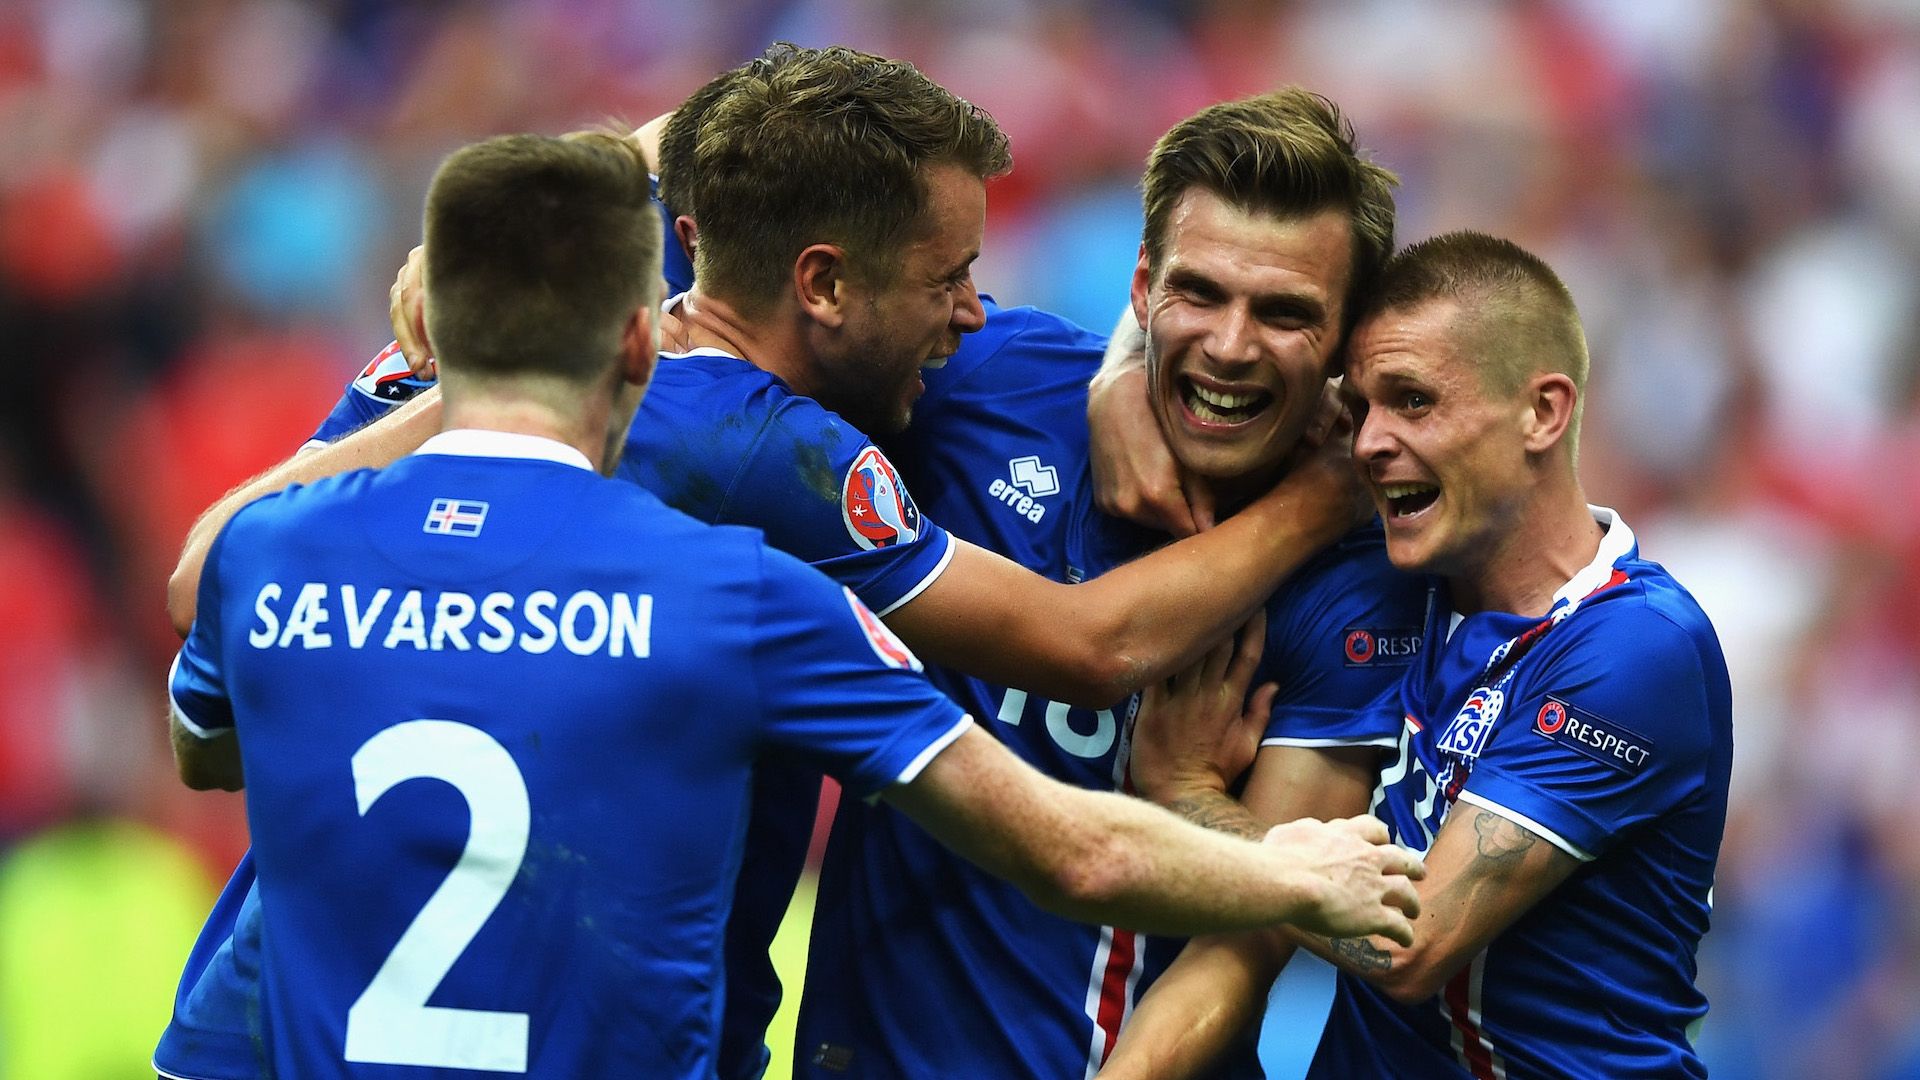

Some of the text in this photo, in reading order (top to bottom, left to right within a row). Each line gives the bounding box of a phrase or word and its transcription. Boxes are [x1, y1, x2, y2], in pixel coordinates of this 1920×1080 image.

[988, 478, 1046, 524] errea
[249, 583, 653, 658] SÆVARSSON
[1565, 718, 1650, 766] RESPECT
[344, 718, 531, 1074] 2
